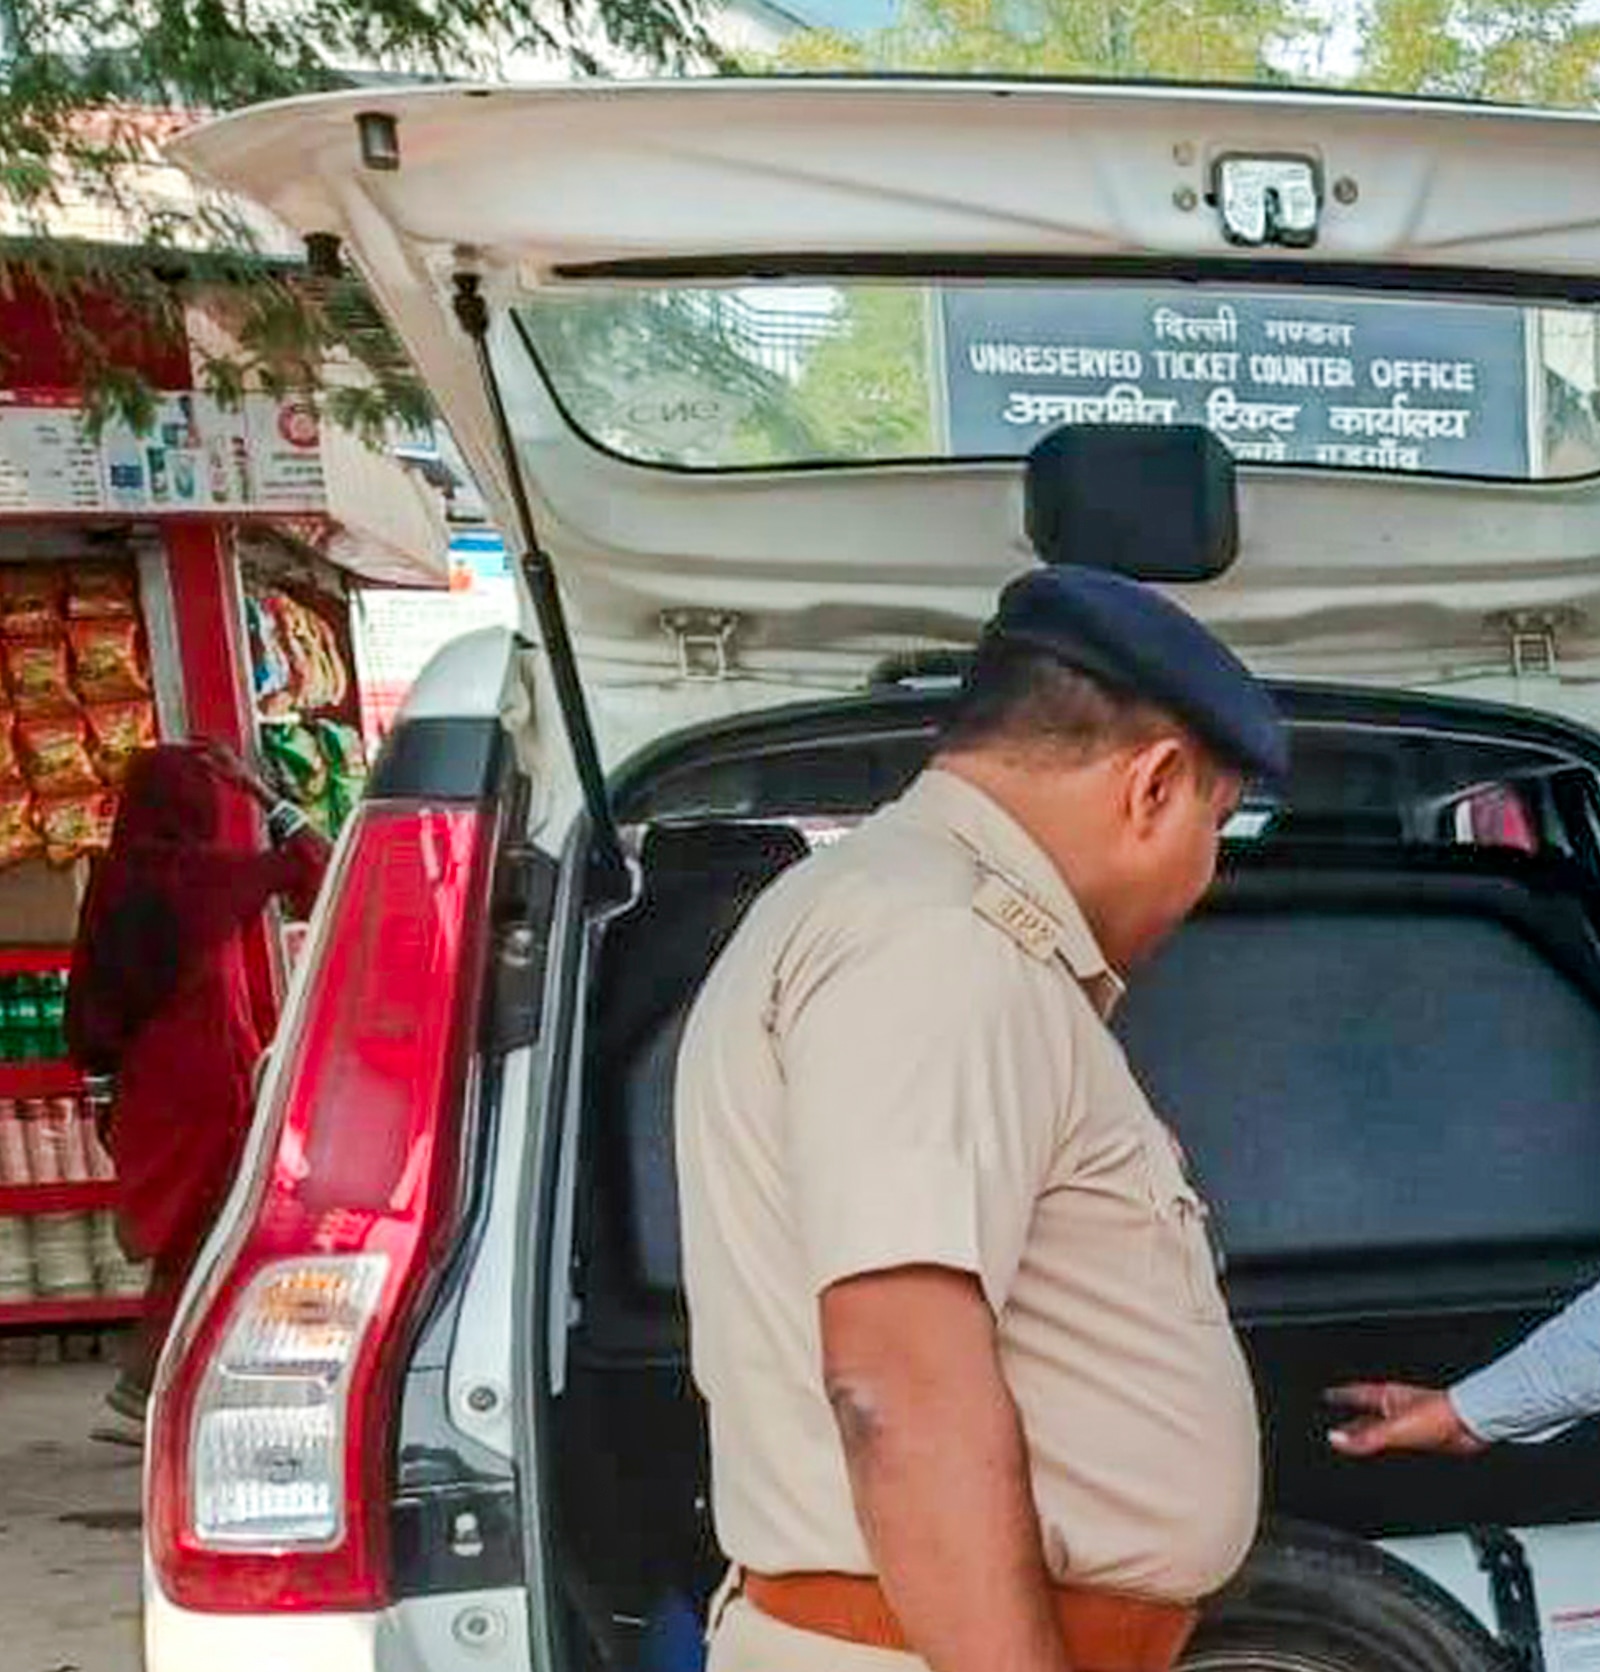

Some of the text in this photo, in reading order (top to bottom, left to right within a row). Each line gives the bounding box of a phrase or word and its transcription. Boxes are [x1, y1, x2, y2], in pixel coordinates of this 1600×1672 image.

[970, 345, 1475, 392] UNRESERVED TICKET COUNTER OFFICE
[1206, 386, 1301, 433] टिकट
[1328, 392, 1471, 440] कार्यालय
